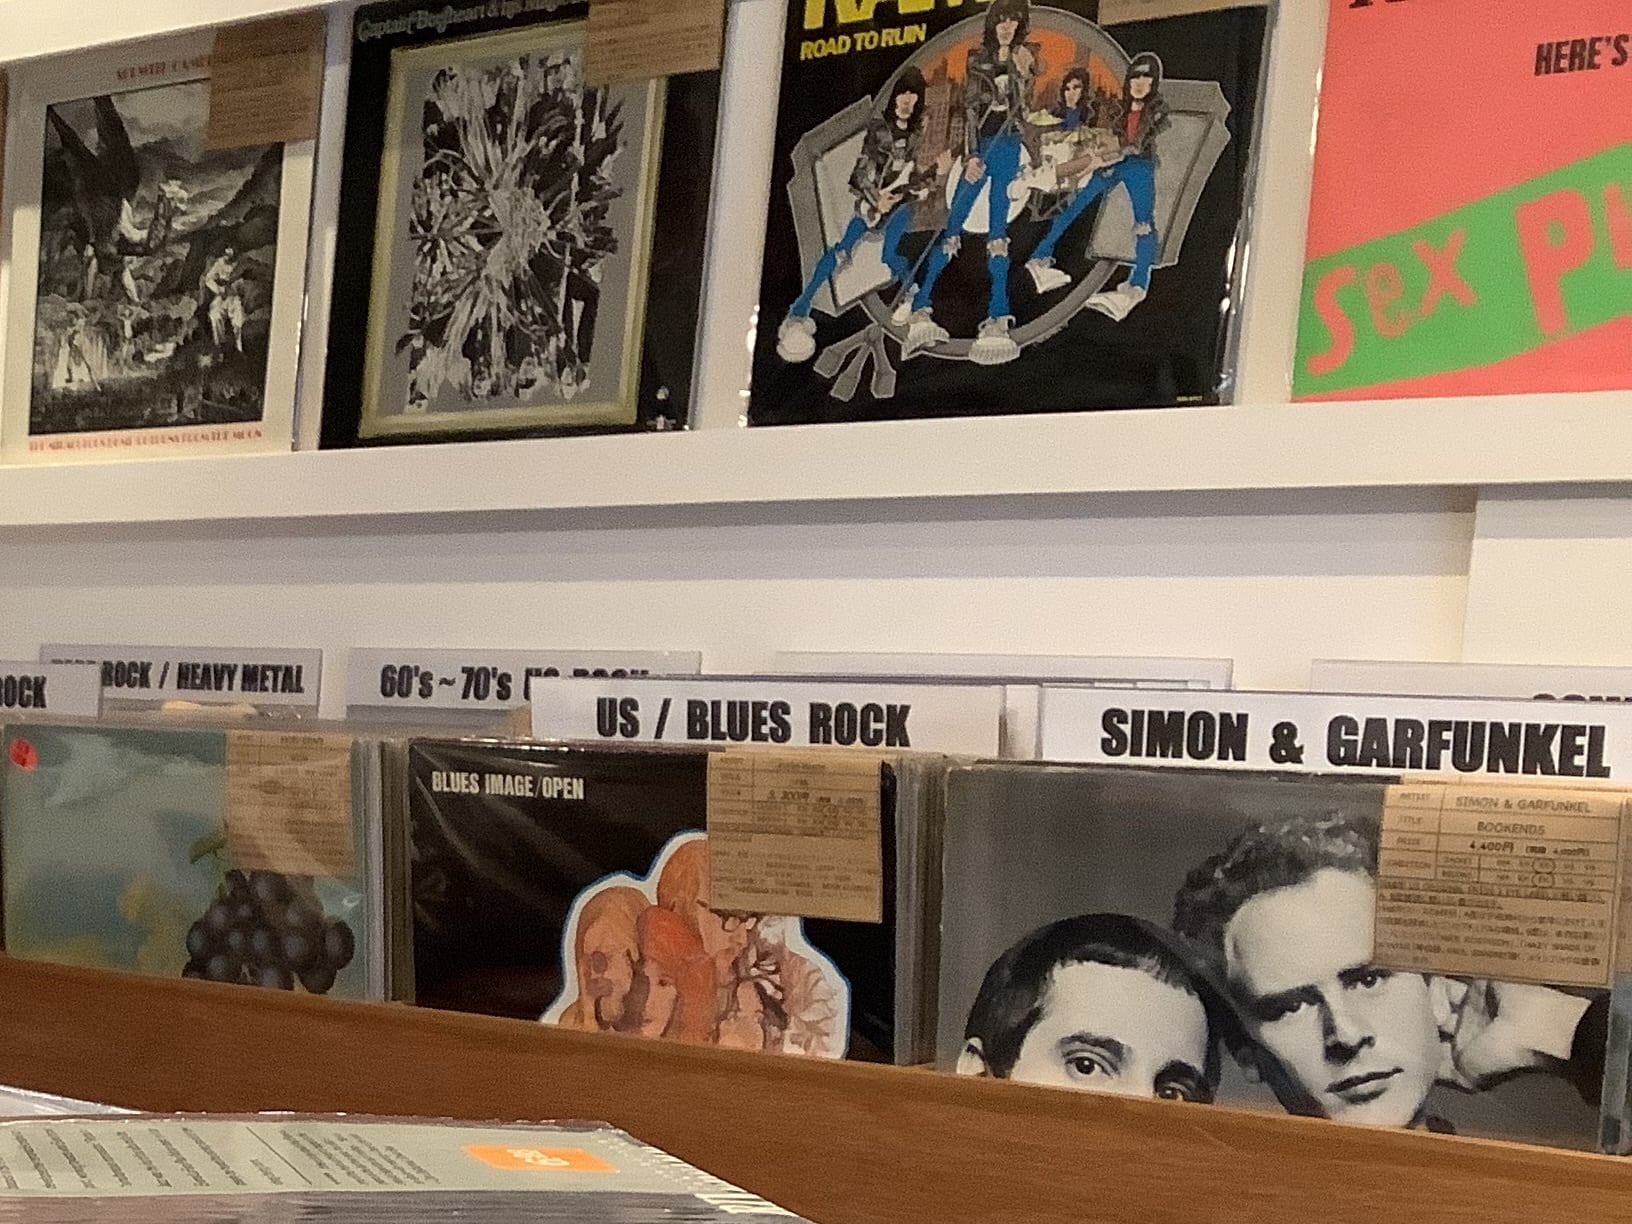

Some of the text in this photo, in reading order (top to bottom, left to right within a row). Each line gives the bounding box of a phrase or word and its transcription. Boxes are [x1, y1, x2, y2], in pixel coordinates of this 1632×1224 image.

[800, 23, 926, 60] ROAD TO RUIN
[1534, 34, 1630, 76] HERE'S
[101, 660, 304, 694] ROCK / HEAVY METAL
[596, 697, 911, 748] US / BLUES ROCK
[1101, 707, 1611, 778] SIMON & GARFUNKEL
[432, 771, 480, 795] BLUES
